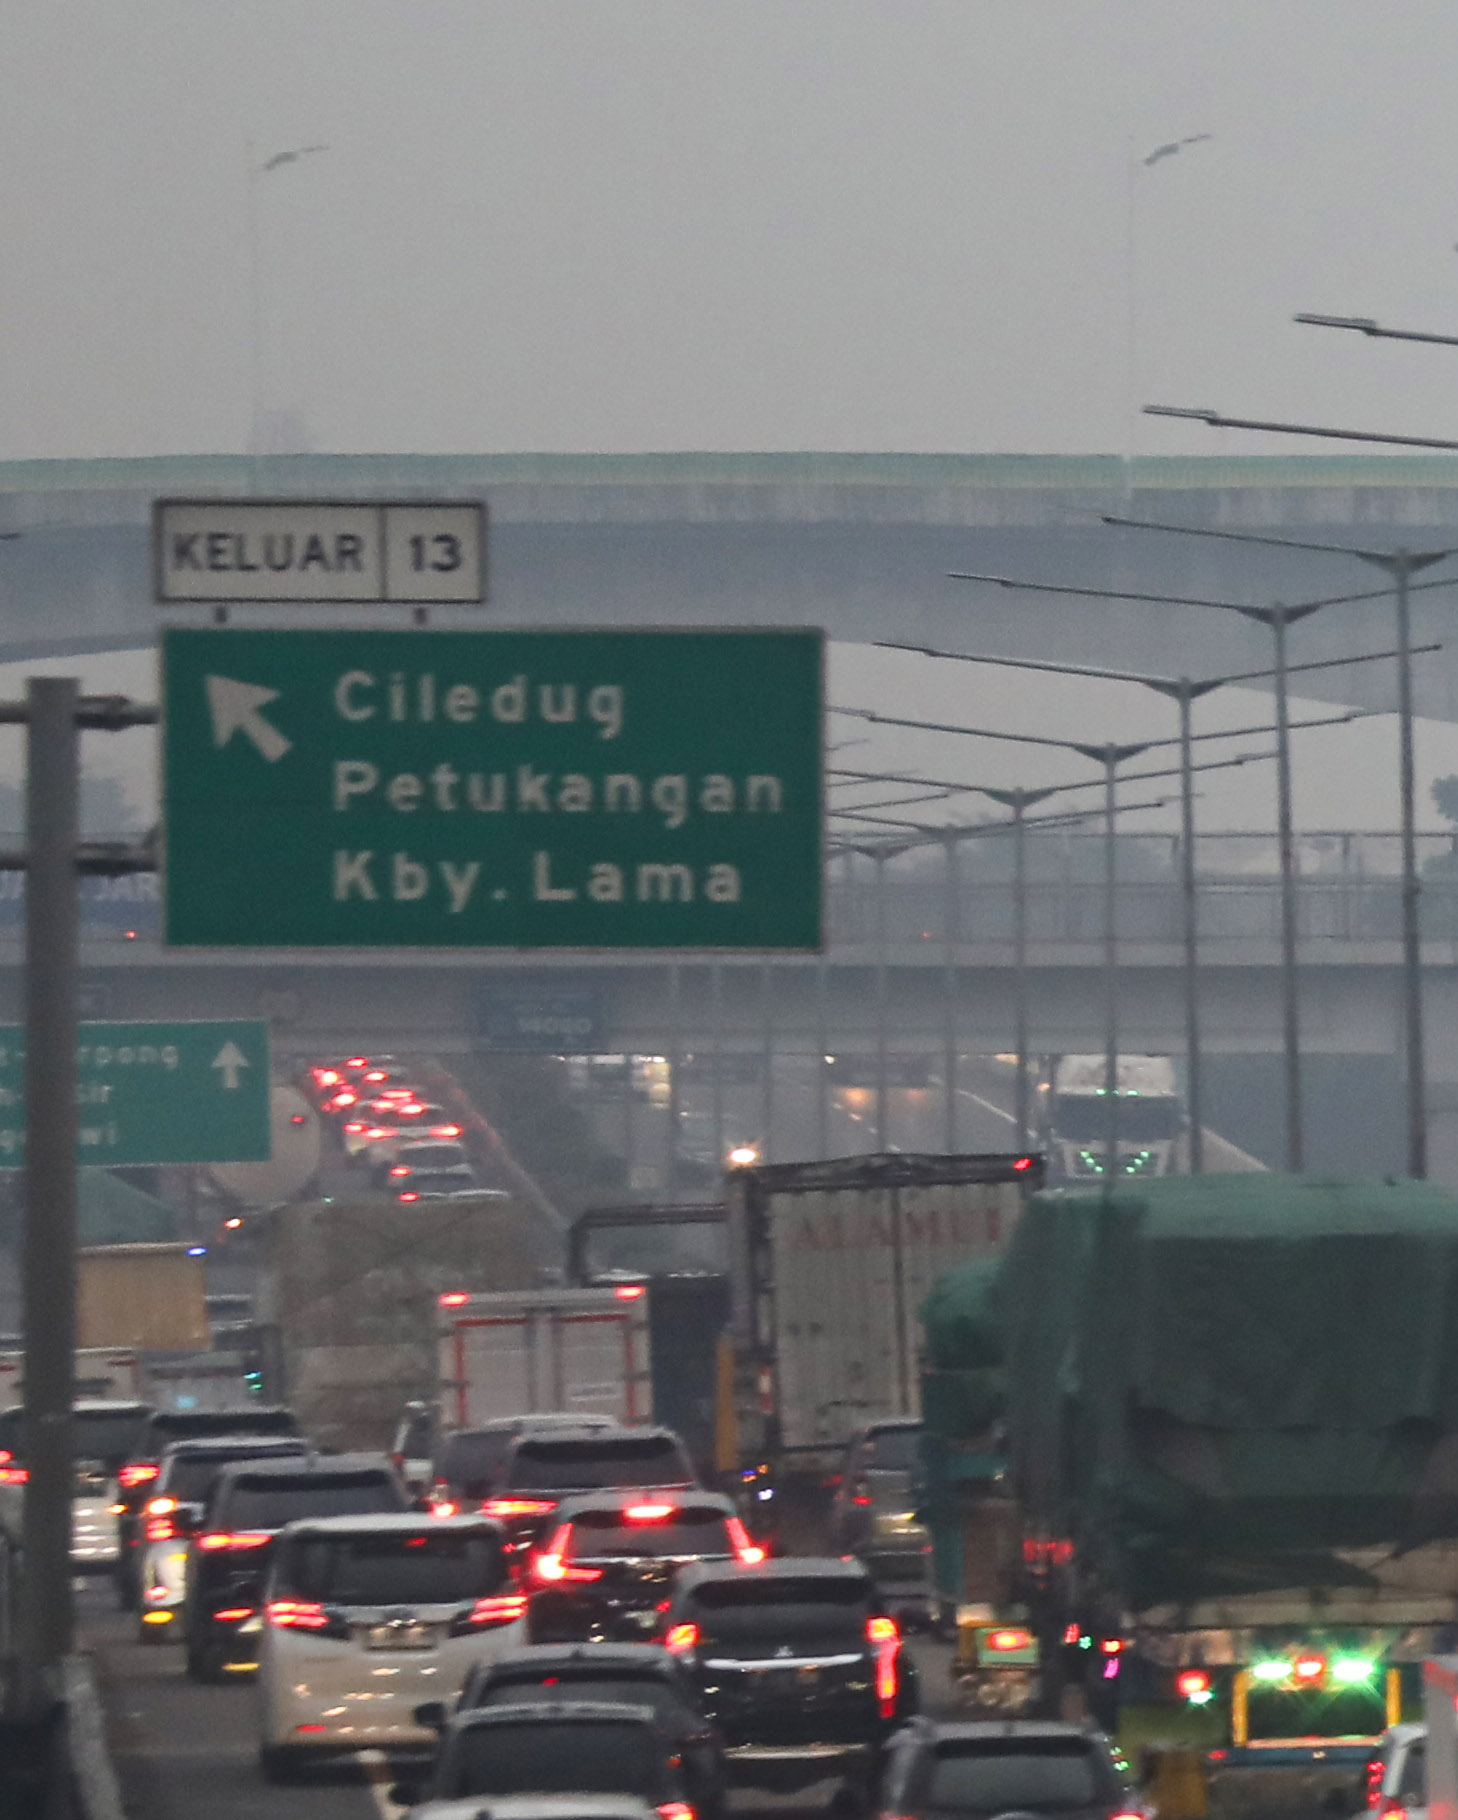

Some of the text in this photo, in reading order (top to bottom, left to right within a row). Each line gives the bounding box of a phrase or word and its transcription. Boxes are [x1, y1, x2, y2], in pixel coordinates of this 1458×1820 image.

[172, 532, 463, 573] KELUAR 13
[333, 670, 624, 740] Ciledug
[332, 760, 783, 829] Petukangan
[332, 850, 742, 913] Kby. Lama
